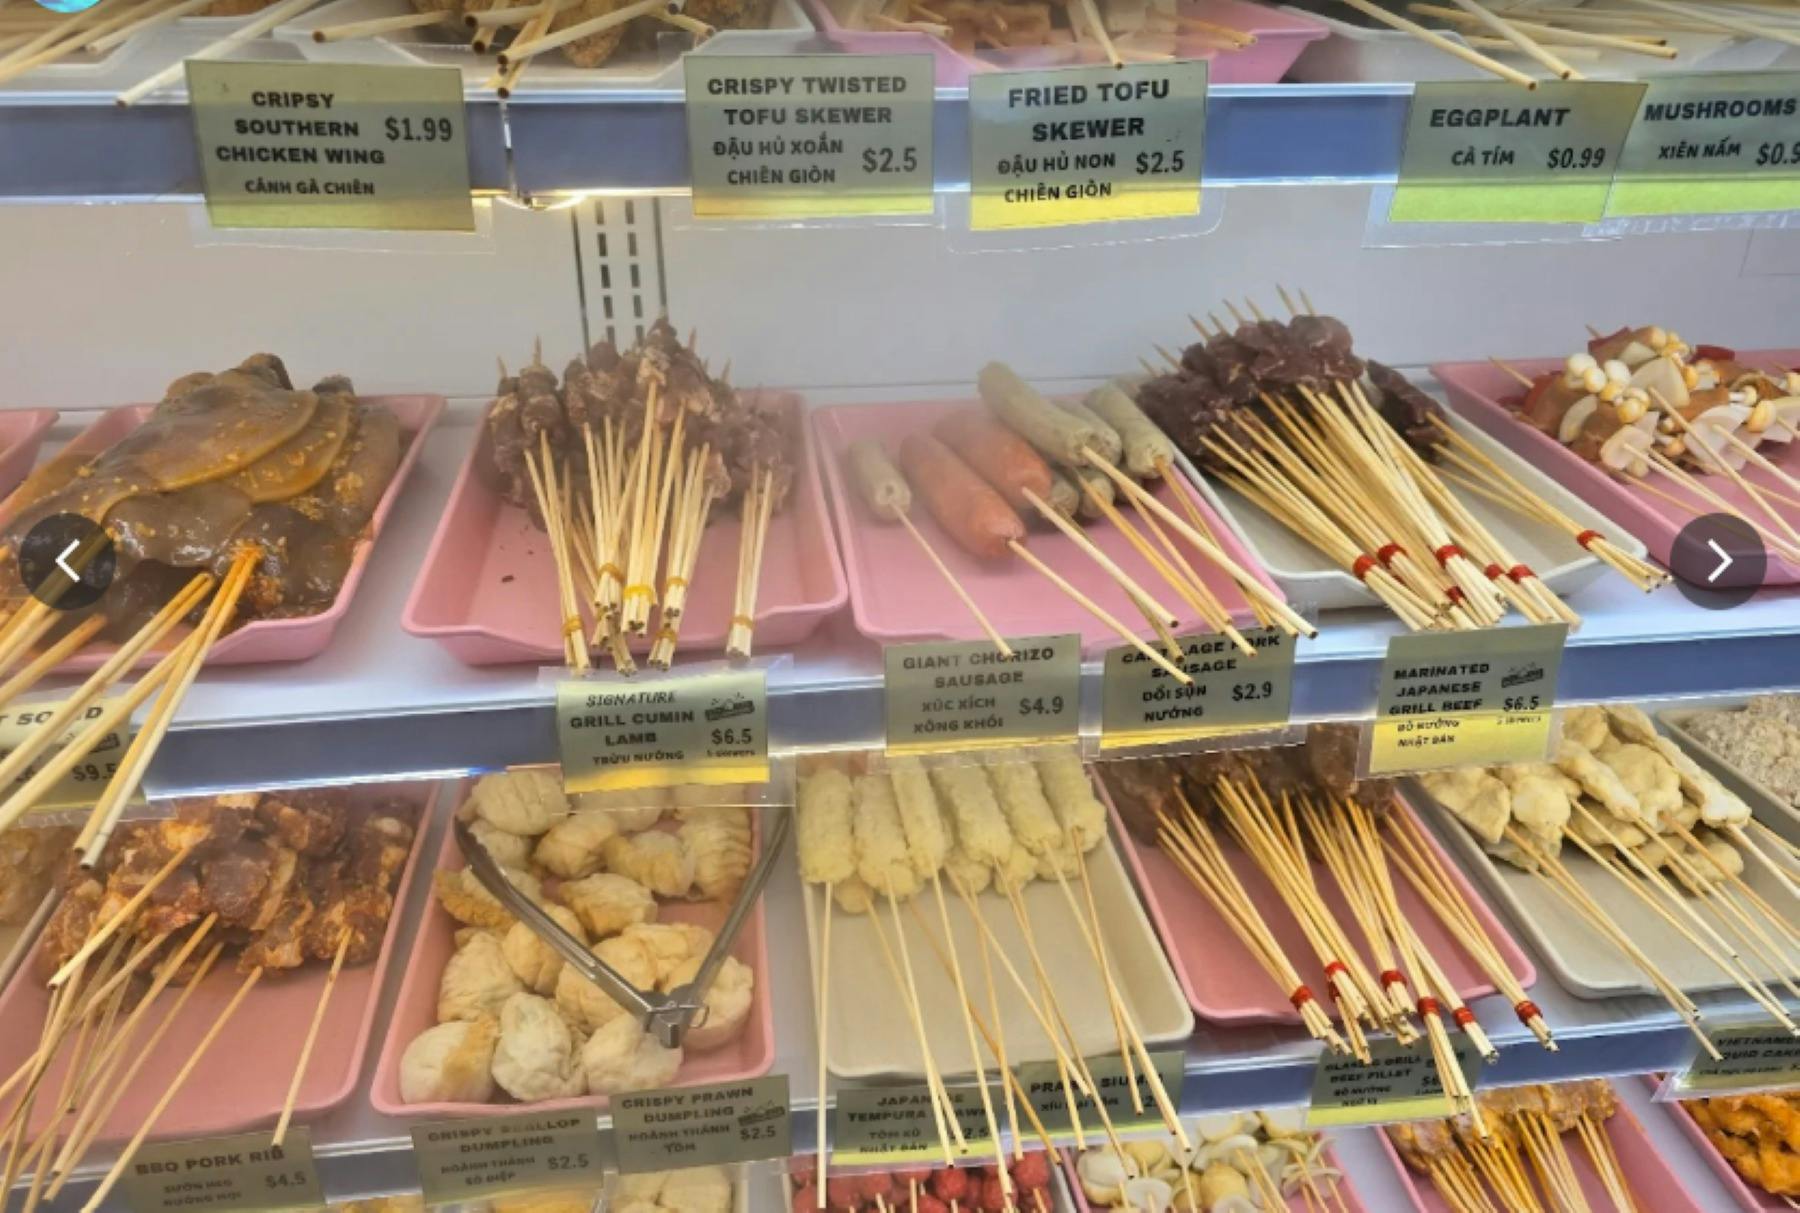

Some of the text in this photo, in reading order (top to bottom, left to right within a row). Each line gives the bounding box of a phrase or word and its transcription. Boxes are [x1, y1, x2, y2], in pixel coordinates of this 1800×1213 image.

[708, 77, 906, 95] CRISPY TWISTED
[1009, 79, 1169, 108] FRIED TOFU
[252, 92, 334, 108] CRIPSY
[724, 107, 892, 125] TOFU SKEWER
[1430, 108, 1570, 128] EGGPLANT
[1644, 98, 1797, 121] MUSHROOMS
[235, 119, 359, 137] SOUTHERN
[385, 117, 453, 142] $1.99
[1032, 118, 1144, 142] SKEWER
[216, 146, 385, 164] CHICKEN WING
[1547, 147, 1606, 169] $0.99
[1658, 140, 1698, 159] XIÊN
[862, 148, 917, 173] $2.5
[1075, 153, 1116, 171] NON
[1136, 150, 1184, 175] $2.5
[727, 166, 783, 184] CHIÊN
[324, 179, 375, 195] CHIÊN
[1005, 184, 1059, 203] CHIÊN
[904, 654, 961, 669] GIANT
[935, 671, 1024, 689] SAUSAGE
[1394, 663, 1490, 680] MARINATED
[1232, 681, 1273, 701] $2.9
[1396, 681, 1483, 697] JAPANESE
[1019, 696, 1064, 716] $4.9
[1389, 698, 1484, 716] GRILL BEEF
[1503, 695, 1540, 713] $6.5
[570, 711, 694, 729] GRILL CUMIN
[605, 732, 657, 746] LAMB
[711, 728, 753, 745] $6.5
[621, 1087, 754, 1110] CRISPY PRAWN
[644, 1106, 735, 1124] DUMPLING
[848, 1110, 927, 1122] TEMPURA
[740, 1125, 776, 1142] $2.5
[461, 1136, 554, 1153] DUMPLING
[135, 1161, 179, 1175] BBQ
[185, 1153, 243, 1171] PORK
[547, 1153, 590, 1170] $2.5
[264, 1171, 306, 1189] $4.5
